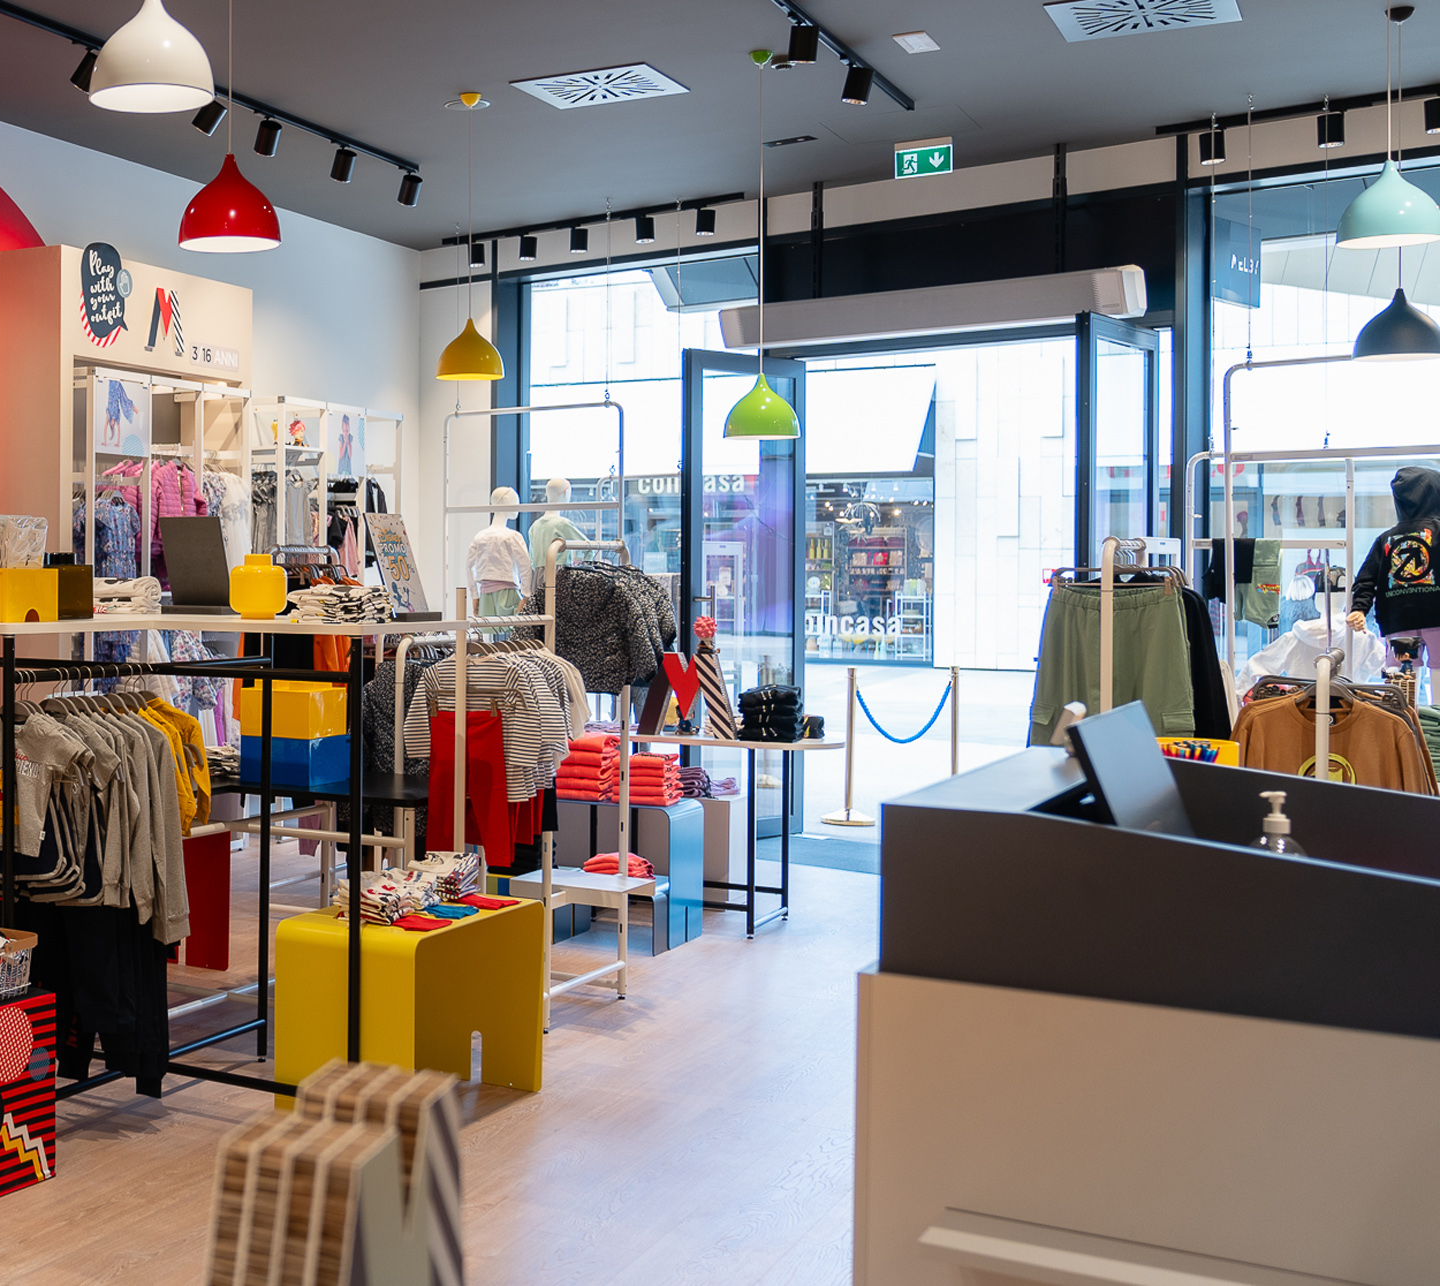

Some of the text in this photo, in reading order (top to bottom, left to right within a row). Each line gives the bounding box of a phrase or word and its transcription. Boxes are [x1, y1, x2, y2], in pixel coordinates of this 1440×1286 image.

[90, 250, 114, 278] Play
[90, 276, 115, 293] with
[90, 294, 115, 310] your
[91, 302, 123, 325] outfit
[214, 350, 238, 368] ANNI
[805, 614, 901, 636] oincasa
